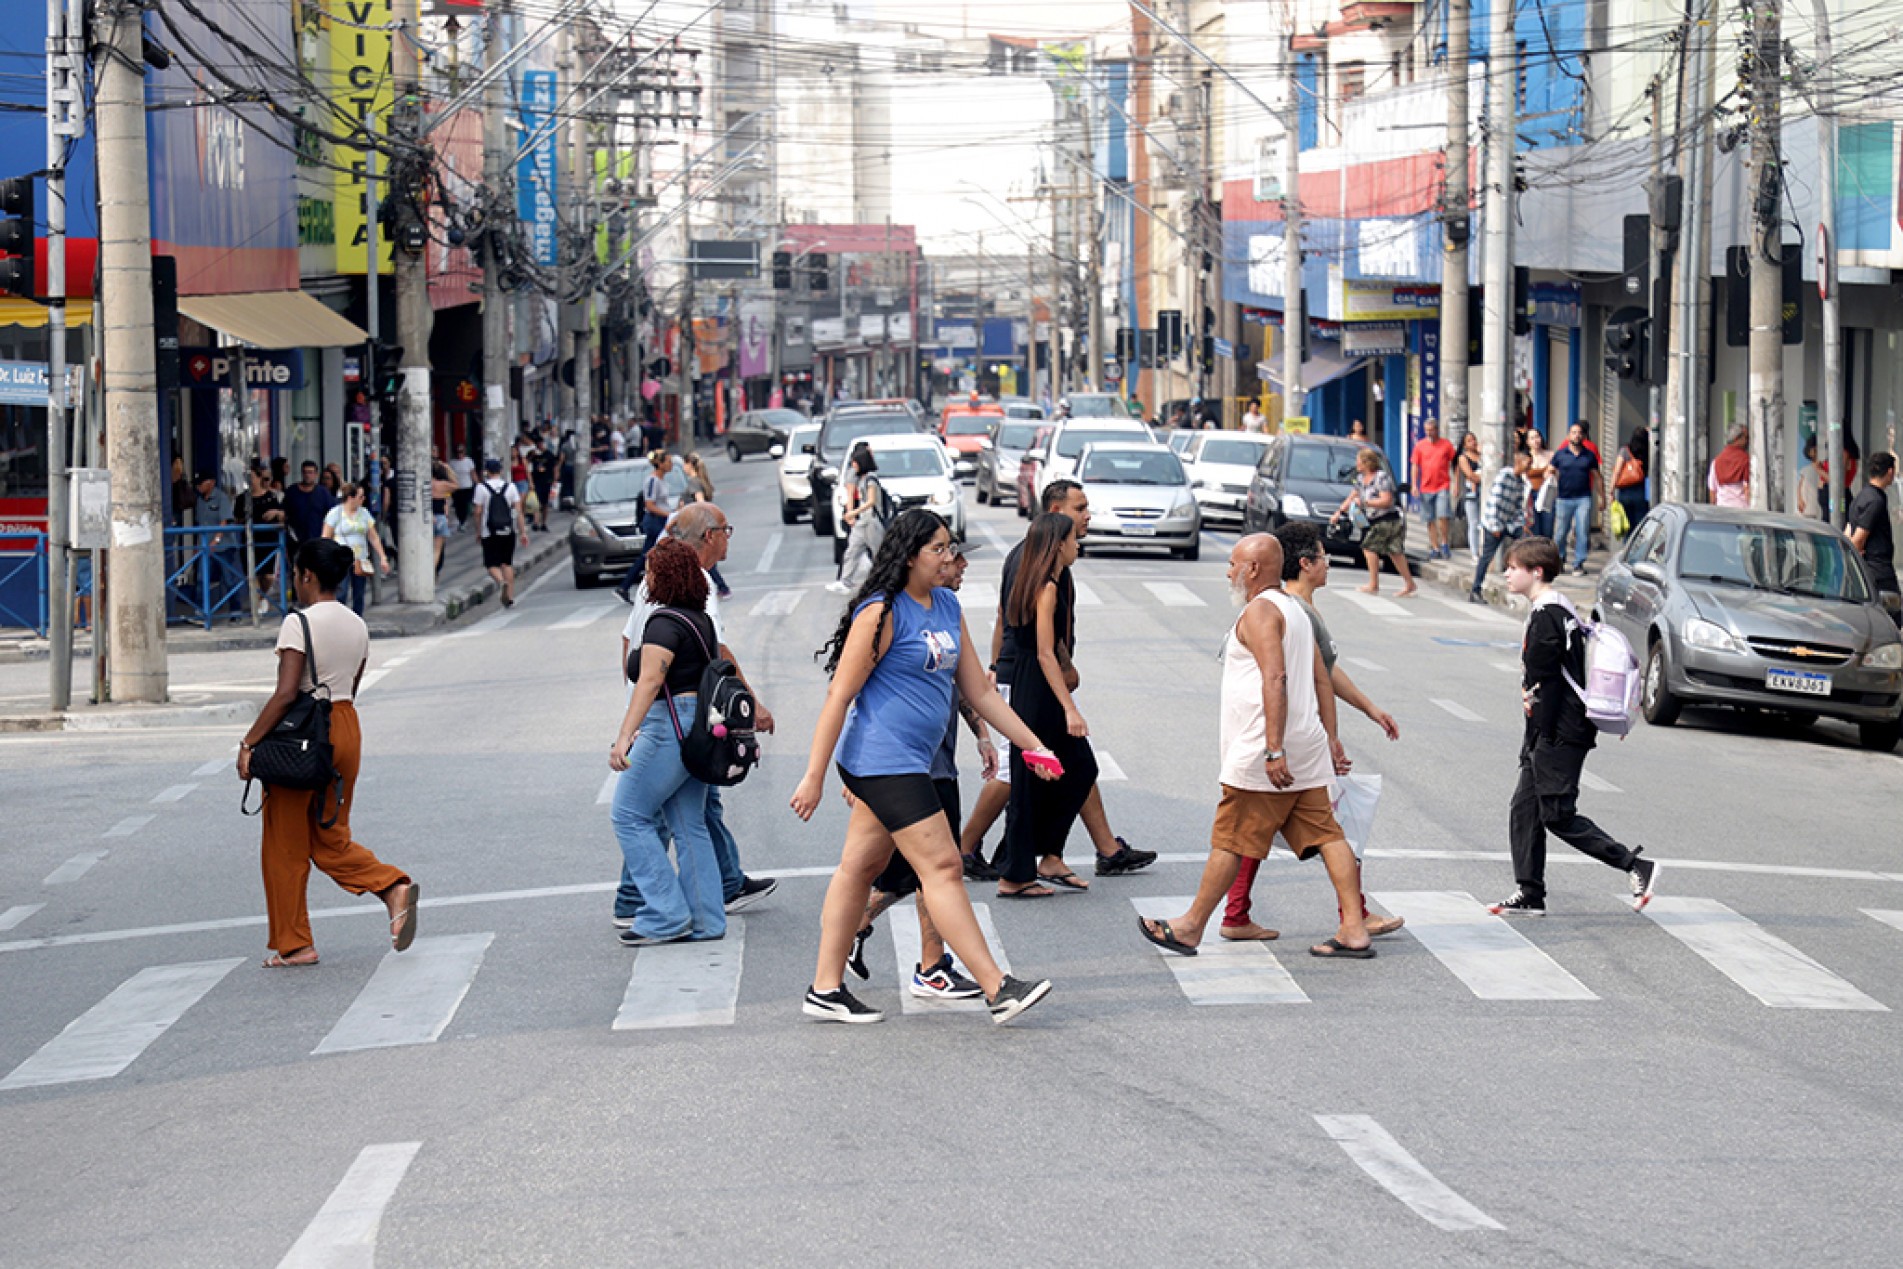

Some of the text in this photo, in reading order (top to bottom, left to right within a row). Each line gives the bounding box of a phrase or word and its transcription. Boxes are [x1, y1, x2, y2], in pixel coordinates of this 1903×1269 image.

[346, 2, 378, 246] VICTRIA
[13, 367, 35, 383] Luiz
[212, 358, 291, 382] Pnte
[1425, 352, 1436, 419] DENTI
